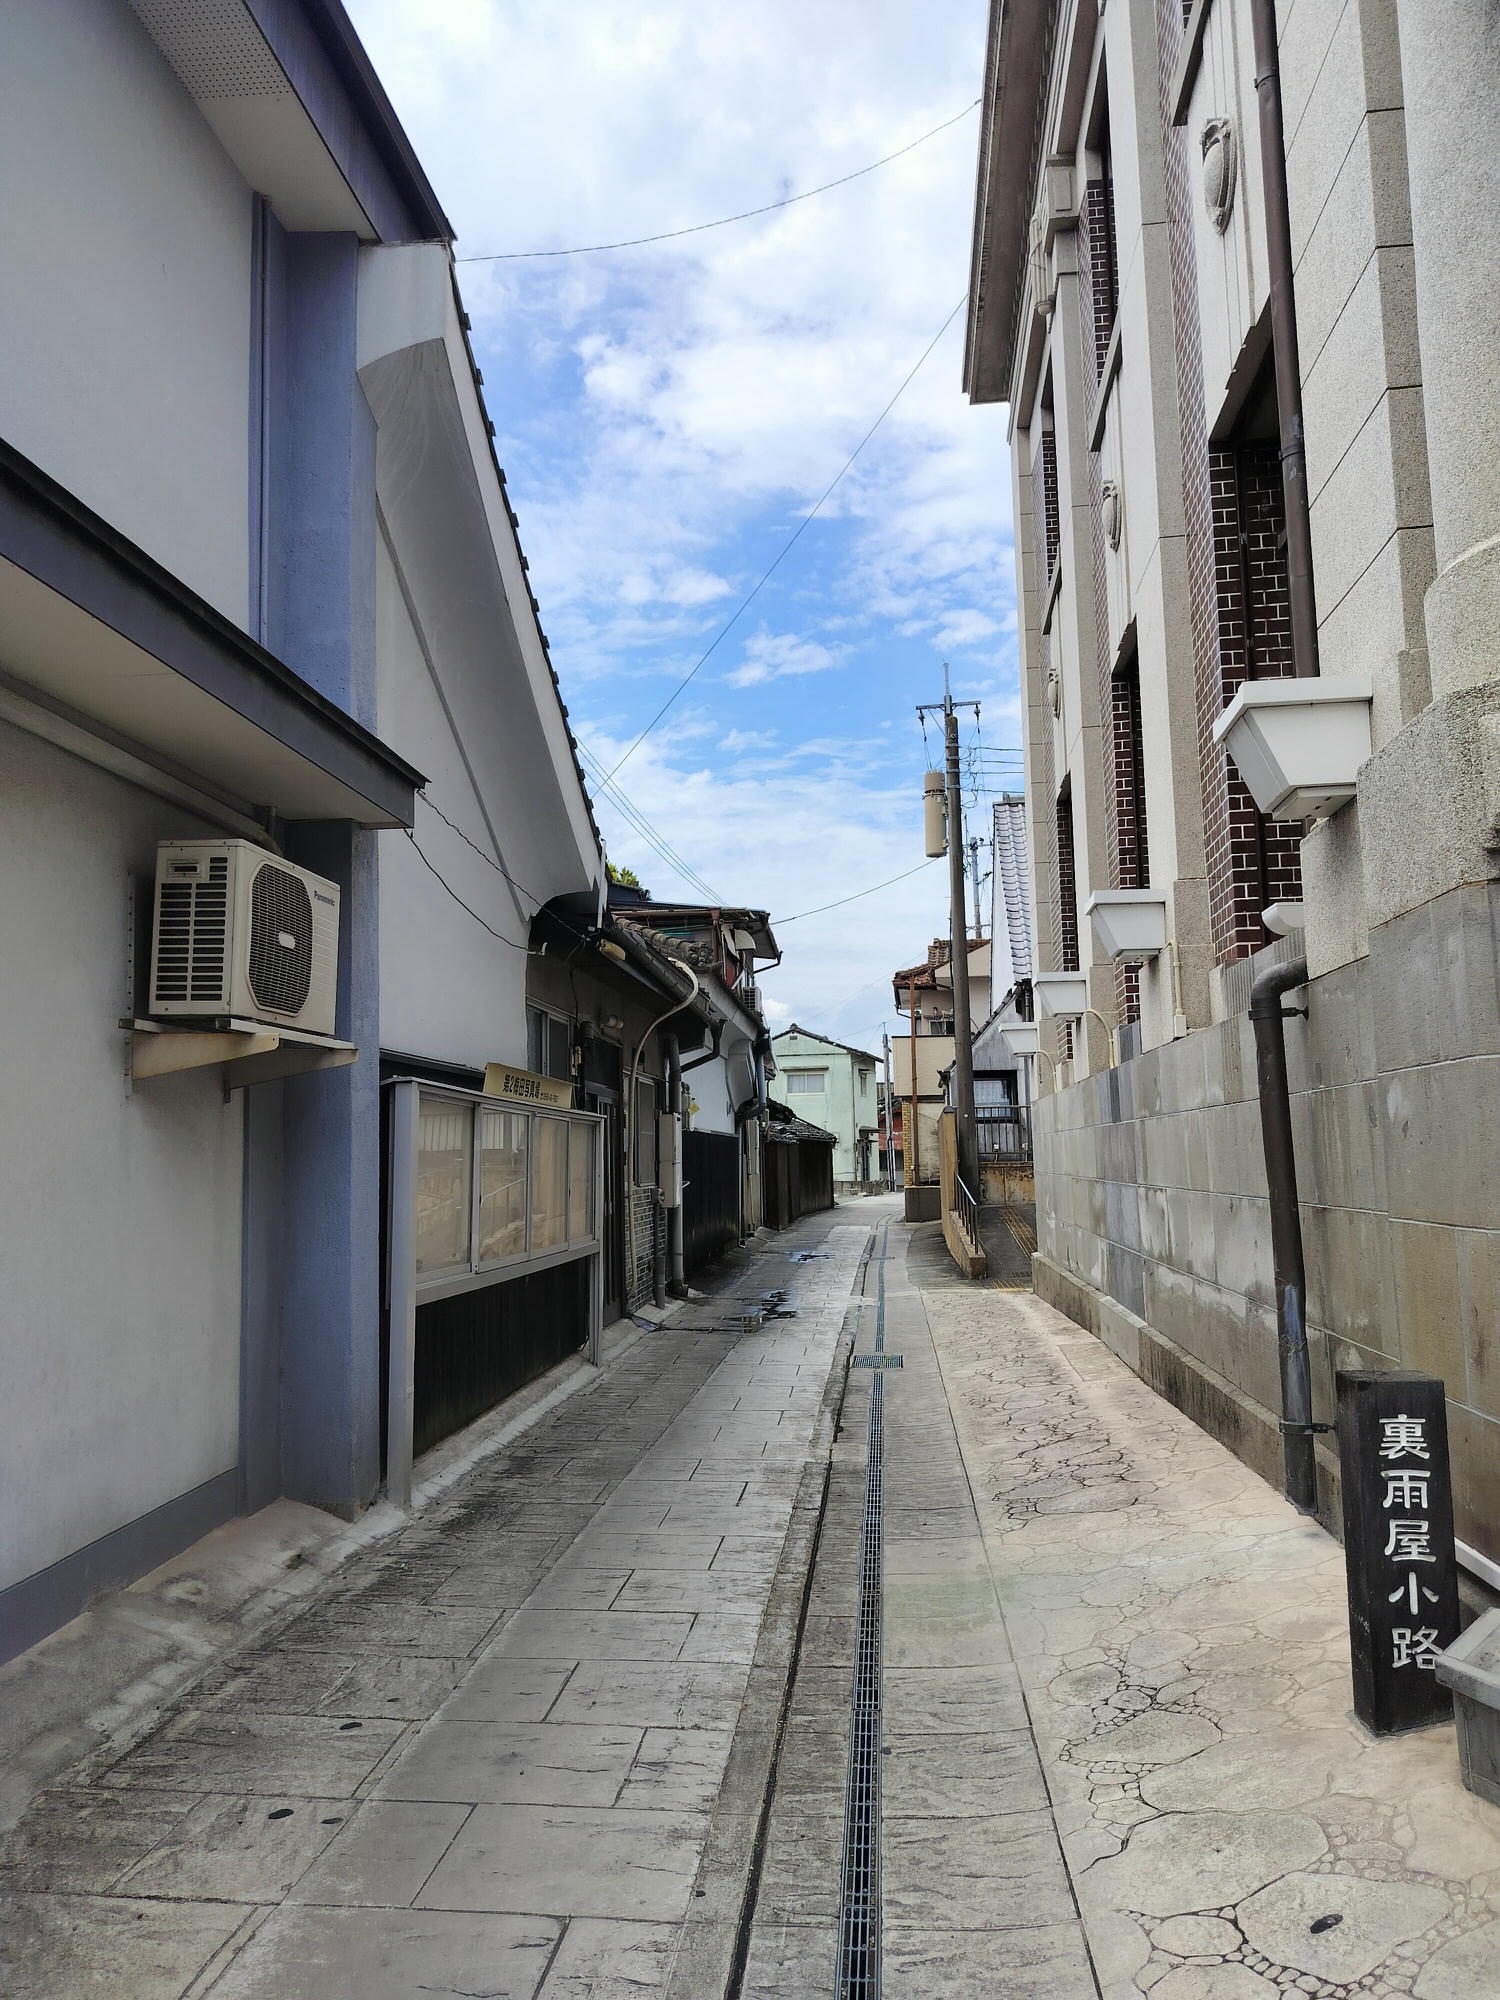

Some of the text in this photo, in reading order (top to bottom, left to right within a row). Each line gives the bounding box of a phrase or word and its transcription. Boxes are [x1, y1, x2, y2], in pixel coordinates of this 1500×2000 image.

[314, 889, 336, 907] Panasonic
[1378, 1413, 1445, 1670] 裏雨屋小路
